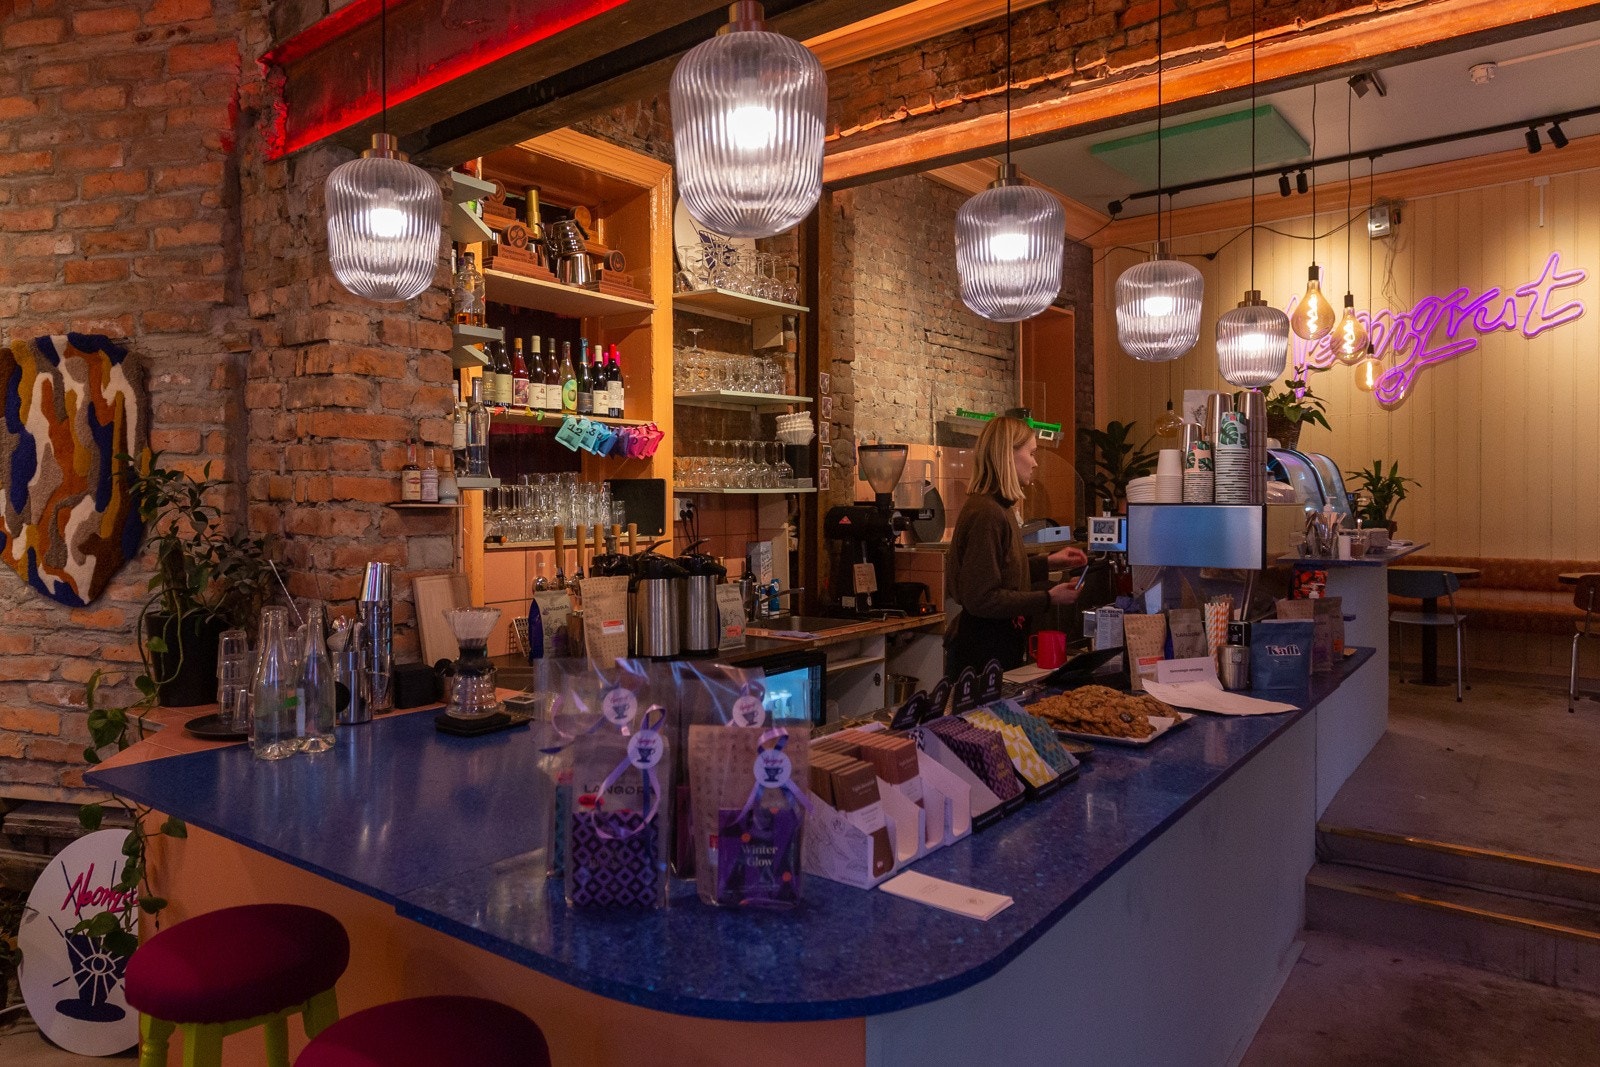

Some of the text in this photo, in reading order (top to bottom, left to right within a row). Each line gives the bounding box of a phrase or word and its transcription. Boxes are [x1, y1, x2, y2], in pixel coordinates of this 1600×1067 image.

[1284, 252, 1586, 404] Nengrut
[741, 845, 778, 855] Winter
[746, 855, 774, 867] Glow
